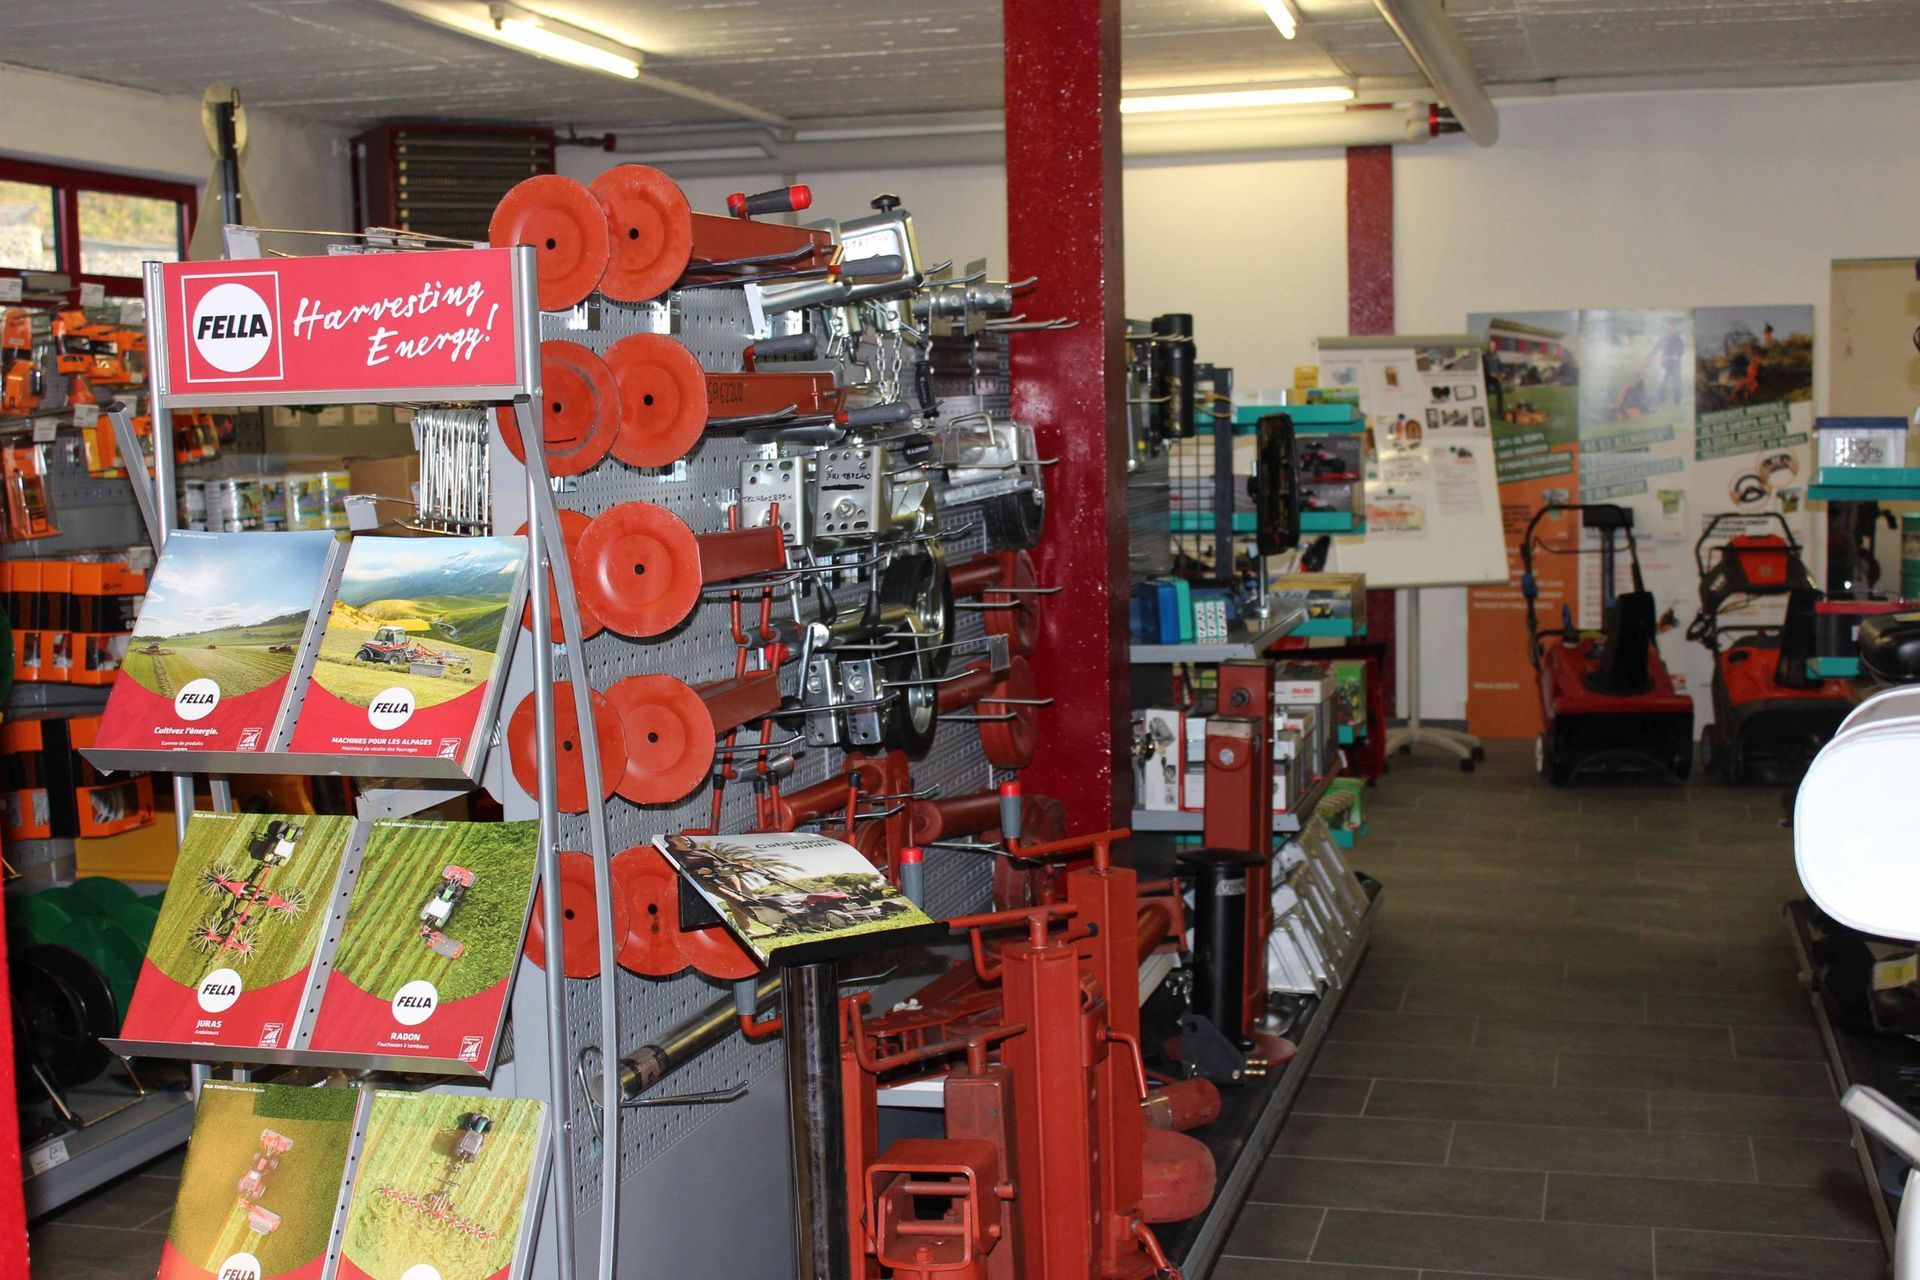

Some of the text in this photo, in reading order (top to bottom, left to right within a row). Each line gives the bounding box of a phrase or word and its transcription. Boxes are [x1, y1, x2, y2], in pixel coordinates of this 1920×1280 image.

[293, 280, 484, 341] Harvesting
[197, 314, 268, 340] FELLA
[366, 303, 499, 366] Energy!
[180, 693, 214, 704] FELLA
[373, 703, 409, 713] FELLA
[154, 727, 184, 735] Cultivez
[331, 737, 367, 745] MACHINES
[755, 839, 829, 849] Catalogue
[792, 841, 837, 851] Jardin
[202, 984, 236, 996] FELLA
[396, 996, 432, 1008] FELLA
[196, 1019, 222, 1028] JURAS
[390, 1032, 421, 1041] RADON
[222, 1269, 256, 1280] FELLA
